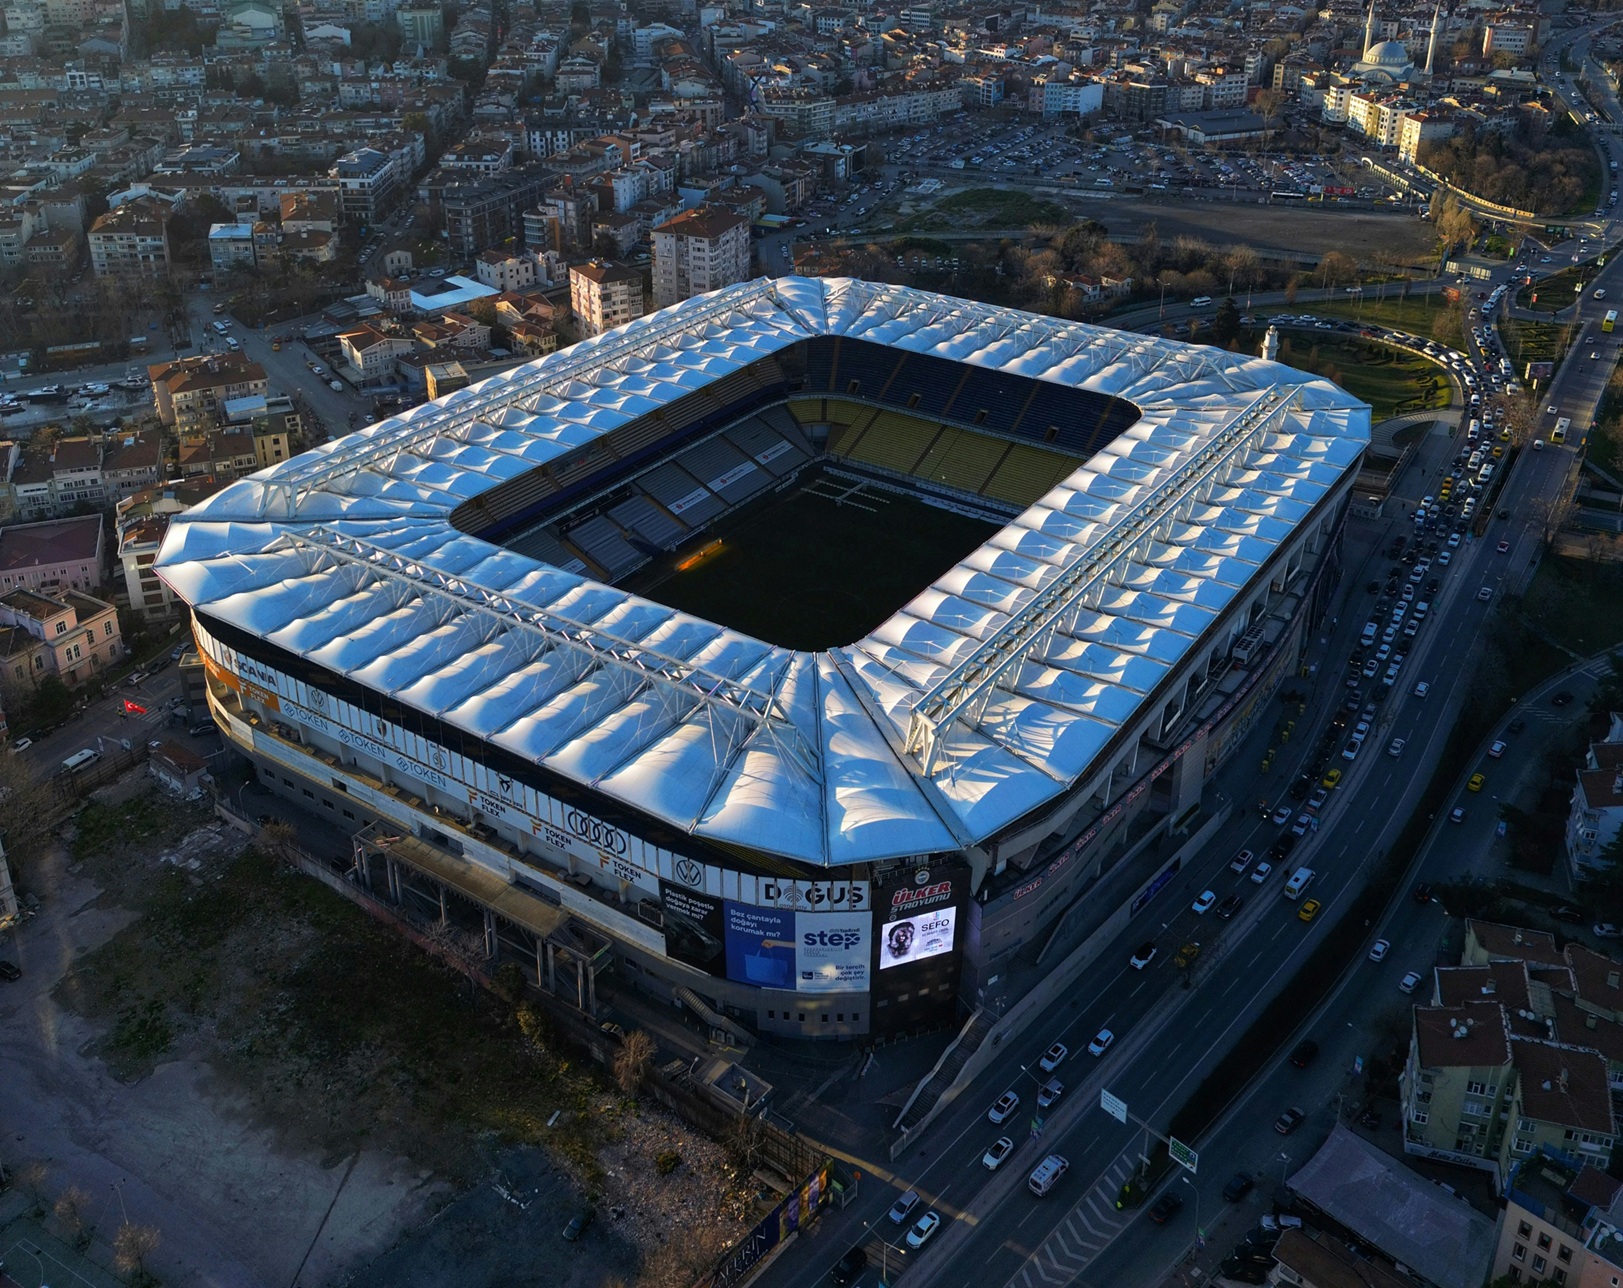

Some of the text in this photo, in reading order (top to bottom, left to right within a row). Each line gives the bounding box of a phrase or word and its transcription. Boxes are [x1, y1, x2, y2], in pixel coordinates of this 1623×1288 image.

[234, 658, 277, 688] SCANIA
[248, 686, 270, 700] TOKEN
[295, 706, 329, 731] TOKEN
[349, 733, 386, 758] TOKEN
[408, 762, 447, 787] TOKEN
[480, 796, 506, 814] TOKEN
[481, 804, 501, 818] FLEX
[544, 827, 572, 846] TOKEN
[546, 835, 566, 850] FLEX
[613, 860, 642, 880] TOKEN
[614, 869, 635, 884] FLEX
[665, 888, 714, 911] Plastik poşetle
[891, 892, 951, 914] STADYUMU
[892, 881, 951, 906] ÜLKER
[665, 895, 708, 916] doğaya zarar
[666, 903, 704, 921] vermek mi?
[730, 908, 781, 925] Bez çantayla
[731, 917, 757, 929] doğayı
[921, 918, 950, 932] SEFO
[731, 923, 781, 939] korumak mı?
[804, 930, 861, 950] step
